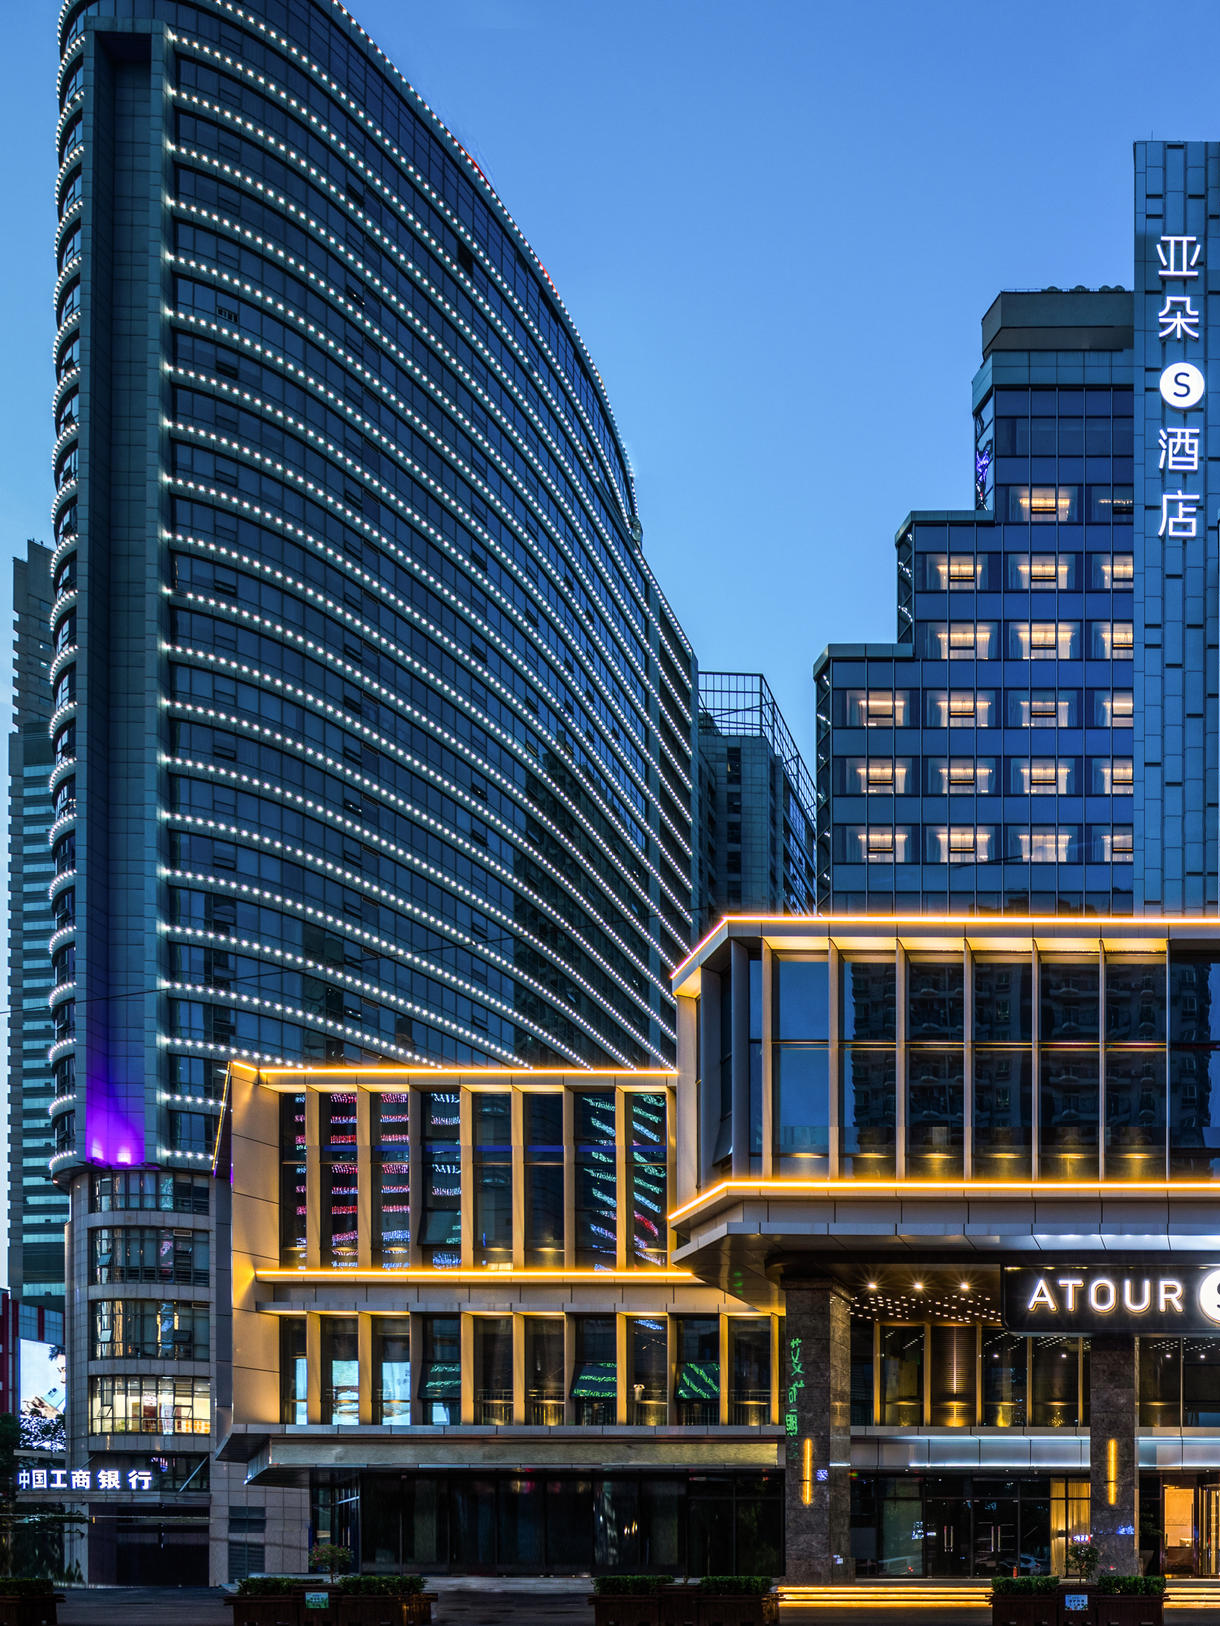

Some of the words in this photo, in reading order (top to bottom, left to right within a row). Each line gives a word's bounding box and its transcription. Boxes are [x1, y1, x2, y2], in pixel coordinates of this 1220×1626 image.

[1156, 236, 1201, 339] 亚朵
[1158, 427, 1200, 537] 酒店
[1028, 1278, 1183, 1313] ATOUR
[18, 1469, 153, 1490] 中国工商银行
